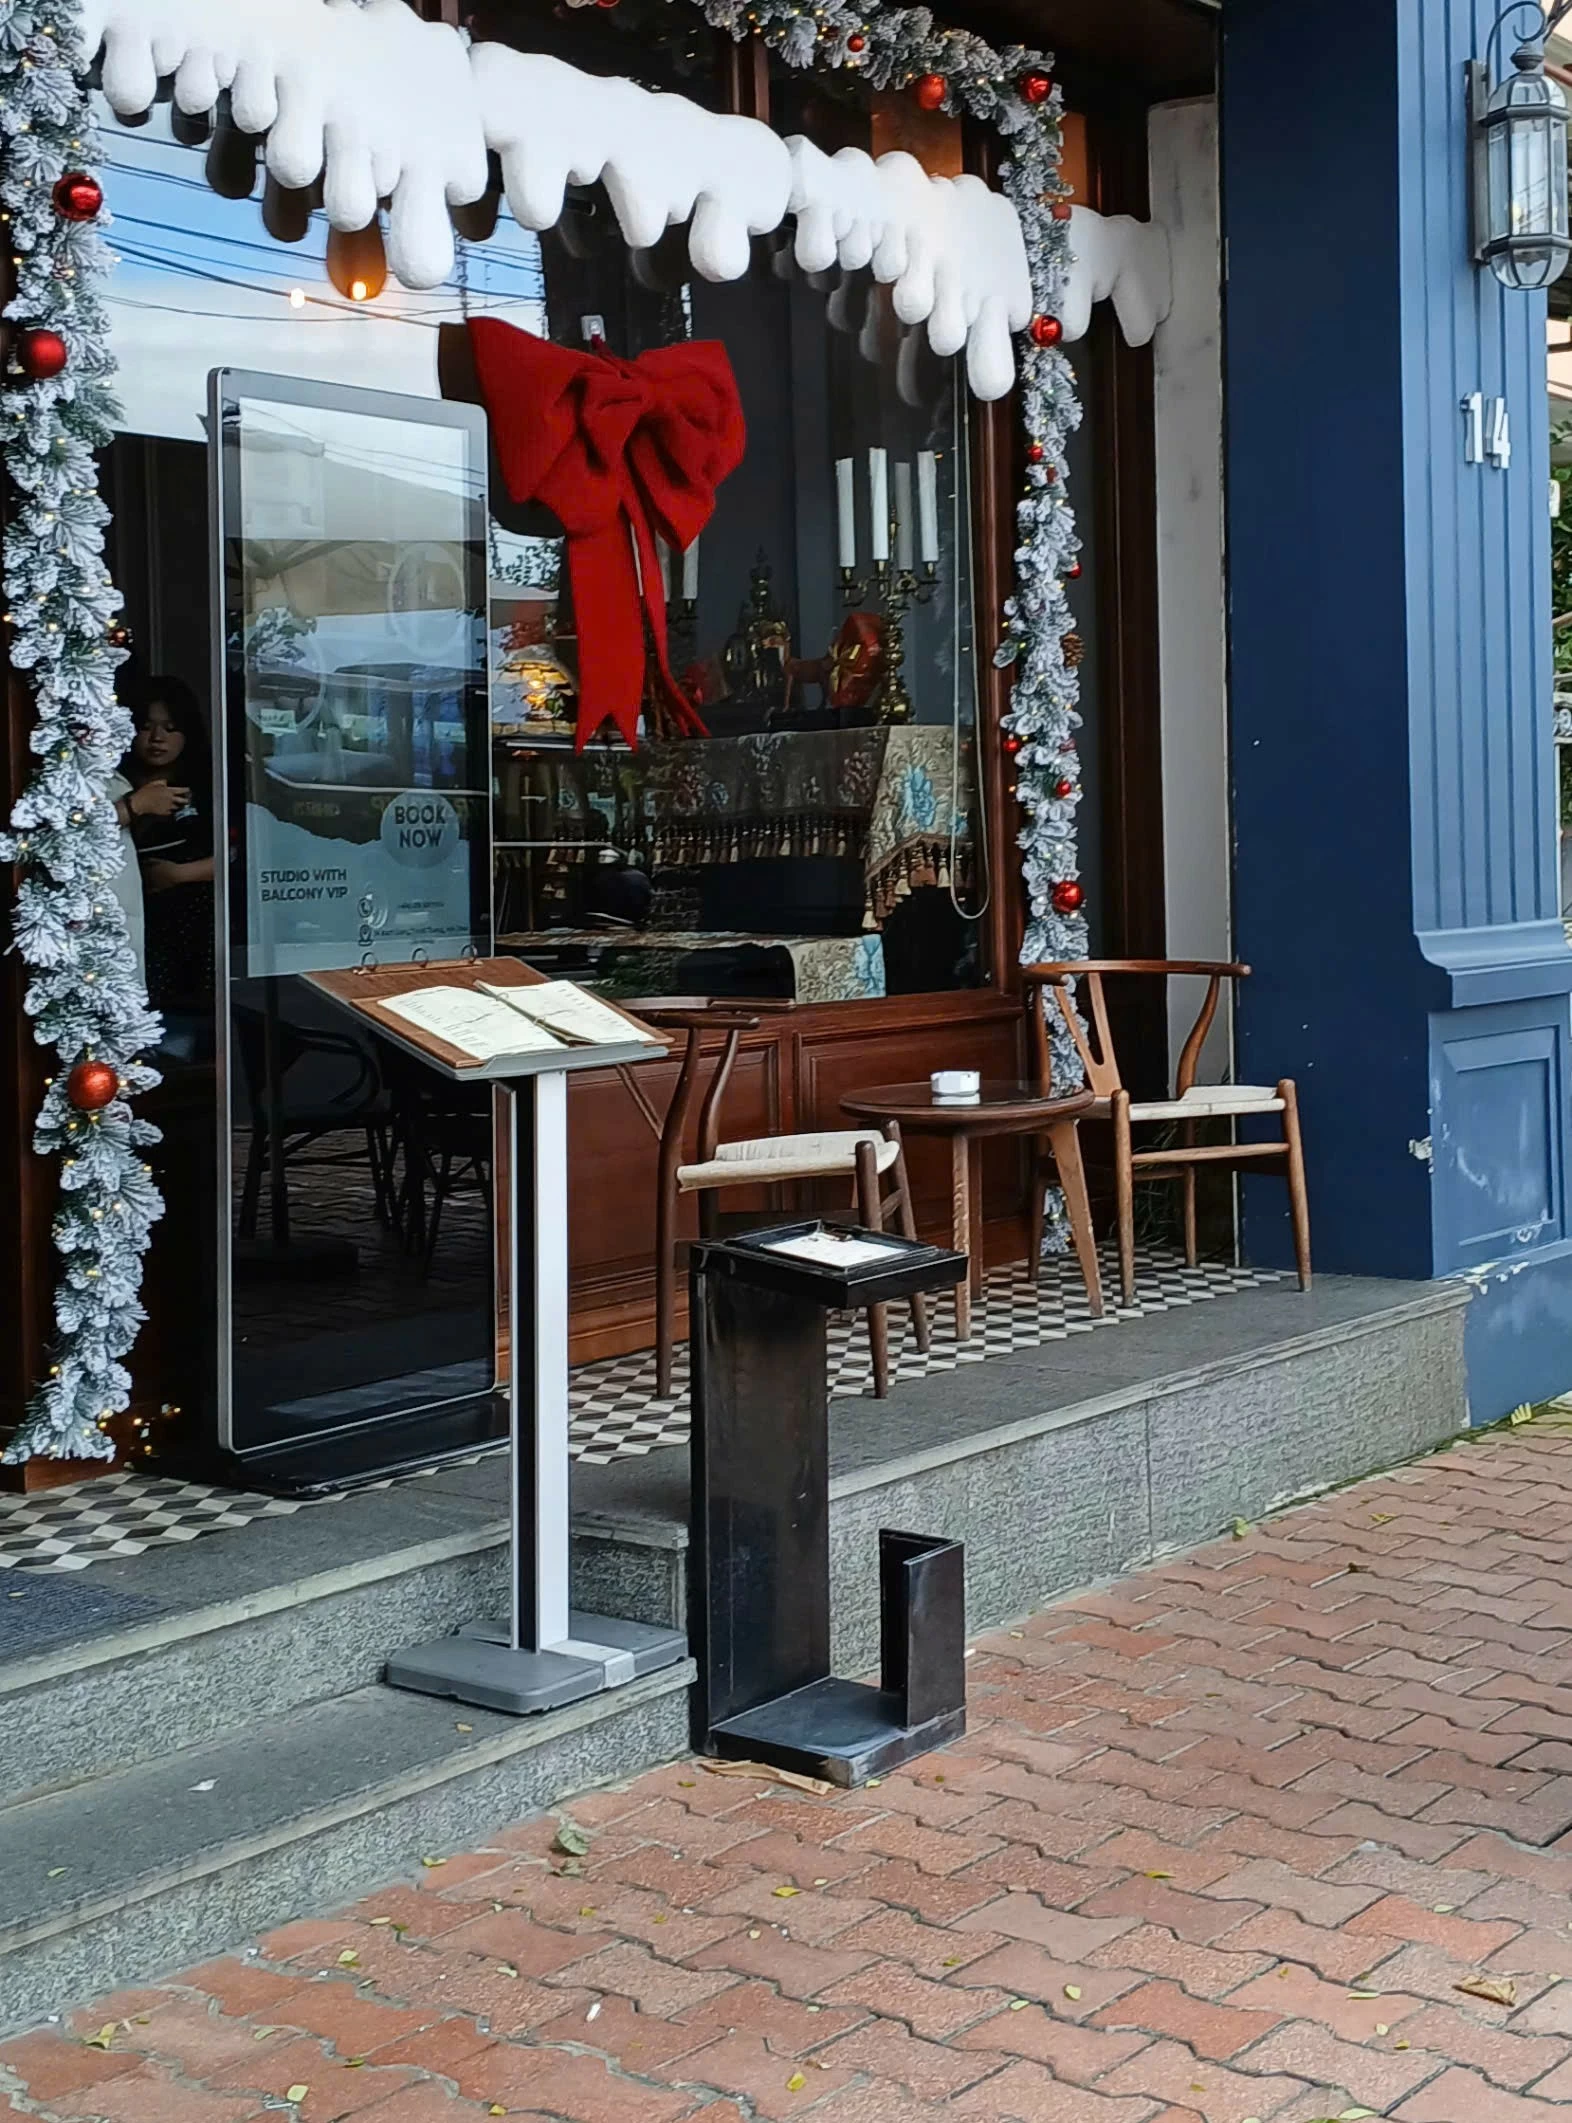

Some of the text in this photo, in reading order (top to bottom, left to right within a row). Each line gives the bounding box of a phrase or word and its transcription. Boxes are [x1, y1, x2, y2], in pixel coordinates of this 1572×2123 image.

[1464, 391, 1511, 469] 14
[394, 804, 446, 825] BOOK
[400, 828, 442, 848] NOW
[260, 868, 347, 883] STUDIO WITH
[261, 886, 349, 902] BALCONY VIP
